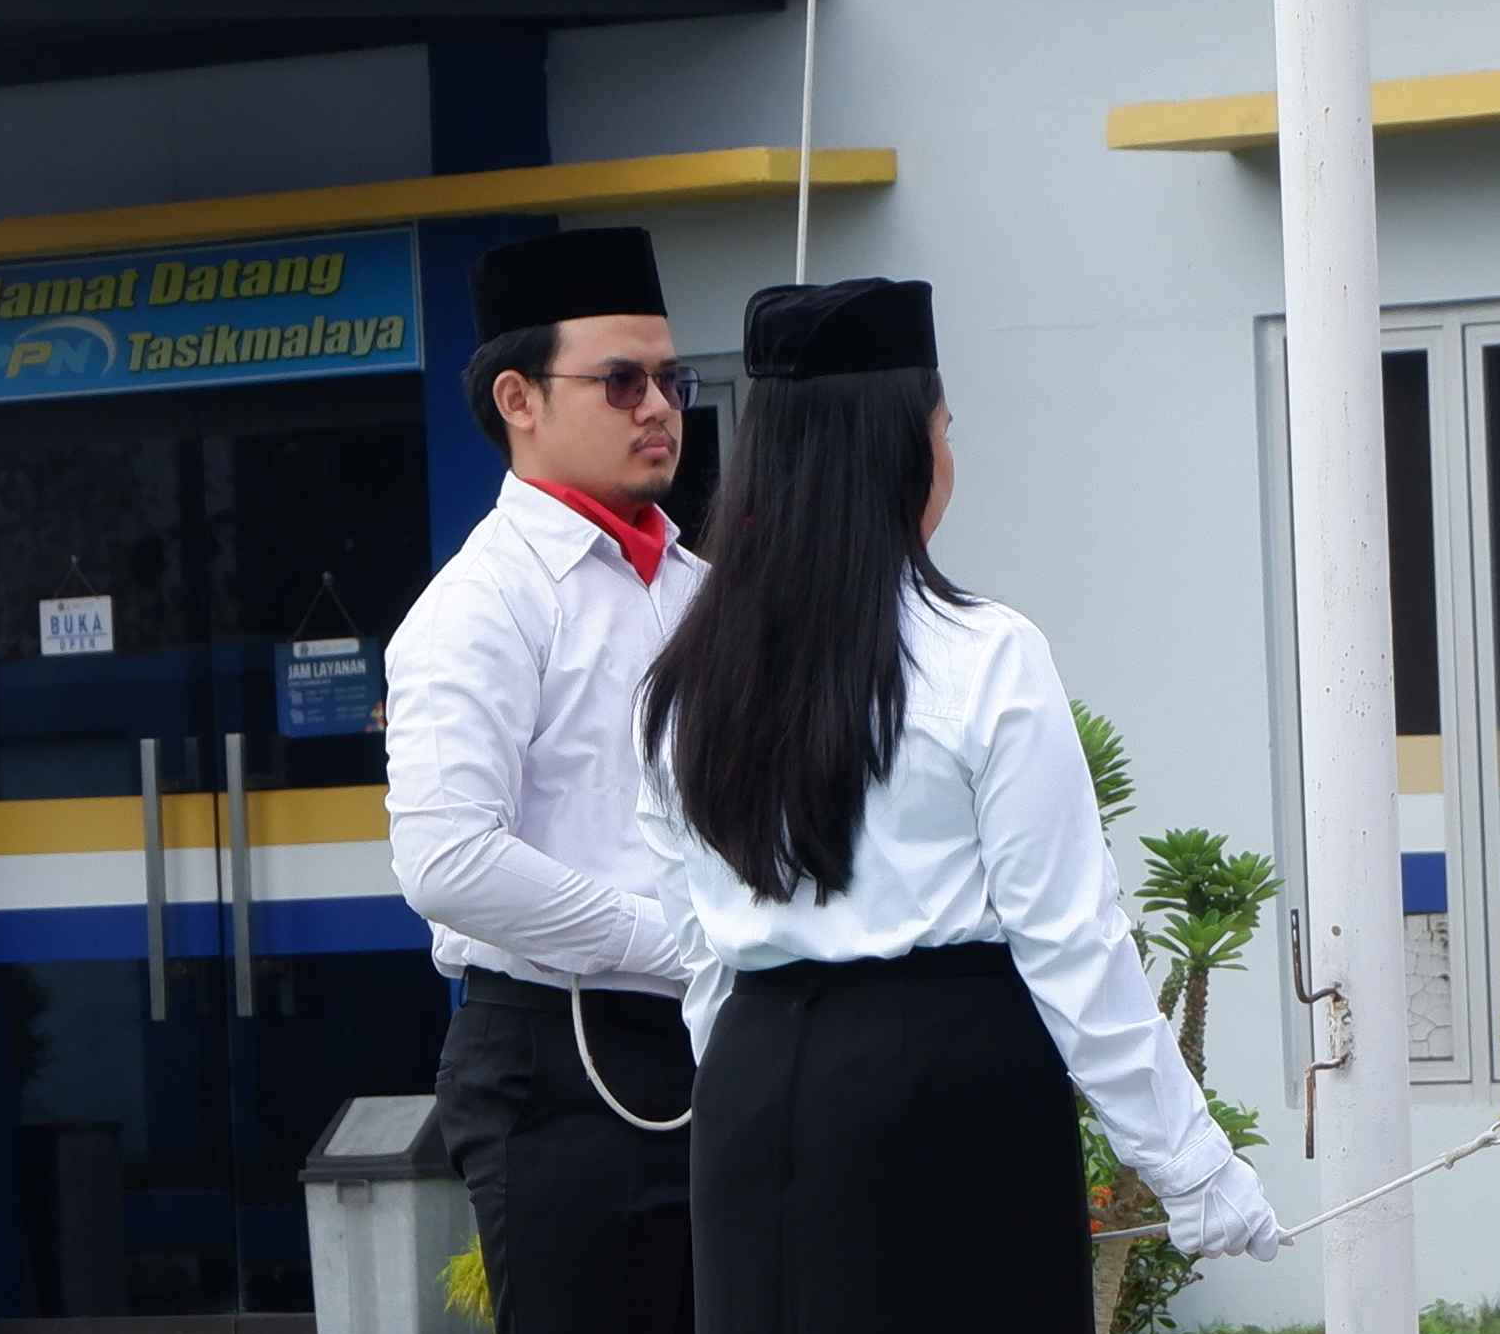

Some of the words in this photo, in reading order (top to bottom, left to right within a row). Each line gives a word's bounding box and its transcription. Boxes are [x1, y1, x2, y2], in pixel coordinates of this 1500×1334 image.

[148, 253, 344, 304] Datang
[127, 315, 405, 370] Tasikmalaya
[51, 613, 102, 636] BUKA
[288, 662, 312, 680] JAM
[313, 658, 367, 678] LAYANAN
